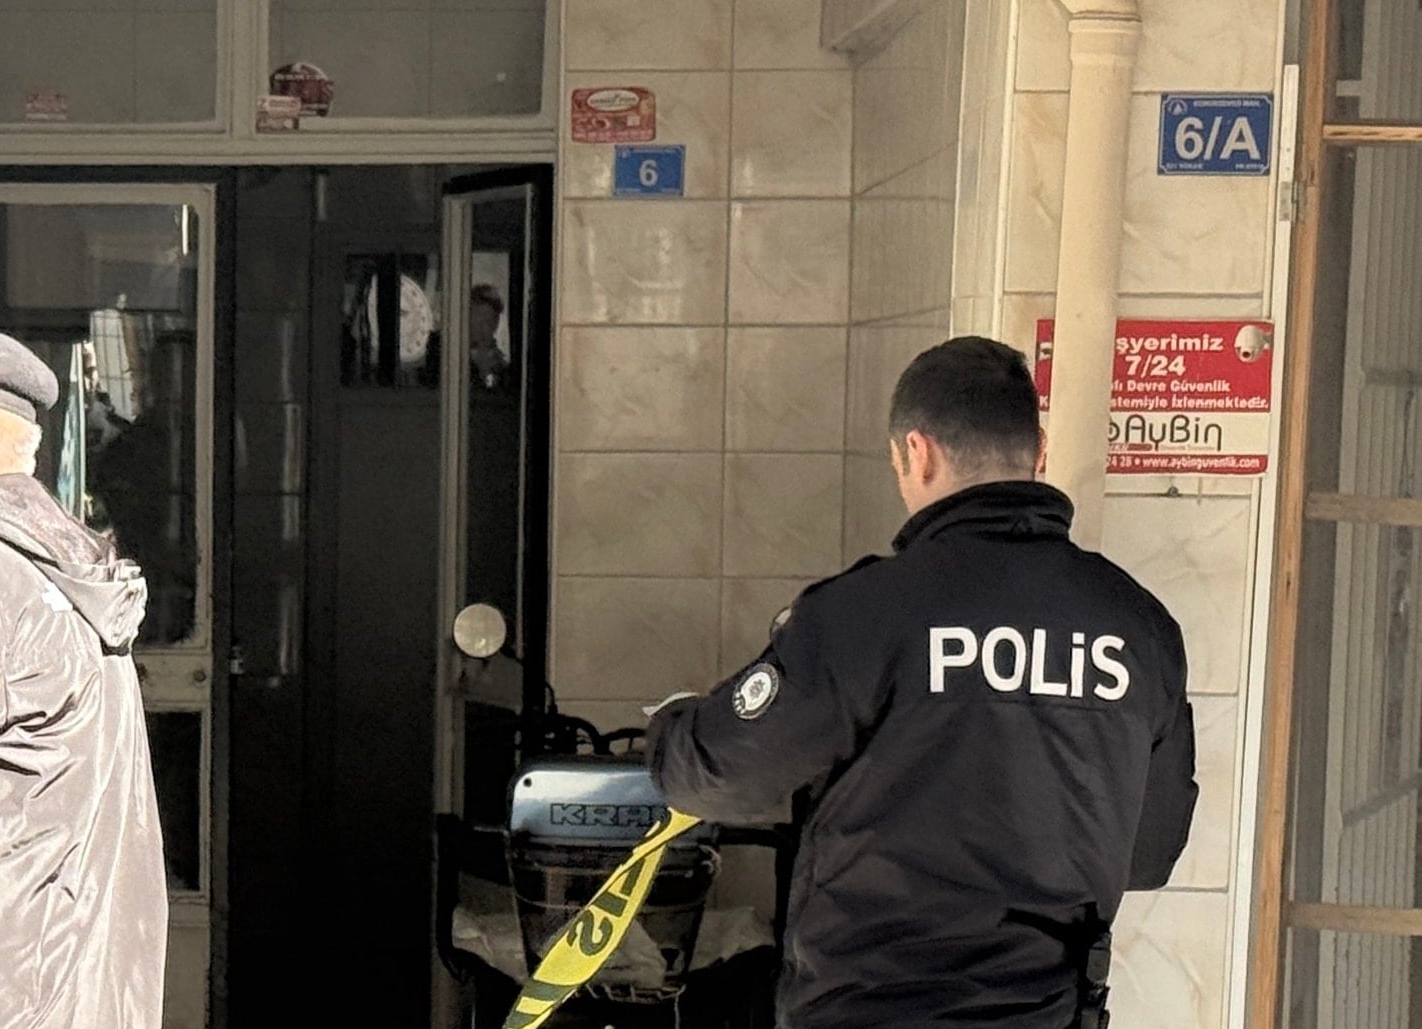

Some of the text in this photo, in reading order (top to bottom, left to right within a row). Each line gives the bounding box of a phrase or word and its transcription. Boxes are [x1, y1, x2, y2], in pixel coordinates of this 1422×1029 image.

[1175, 116, 1261, 160] 6/A
[639, 160, 658, 187] 6
[1115, 333, 1224, 354] şyerimiz
[1125, 355, 1186, 378] 7/24
[1127, 380, 1166, 392] Devre
[1170, 379, 1231, 392] Güvenlik
[550, 803, 668, 827] KRA
